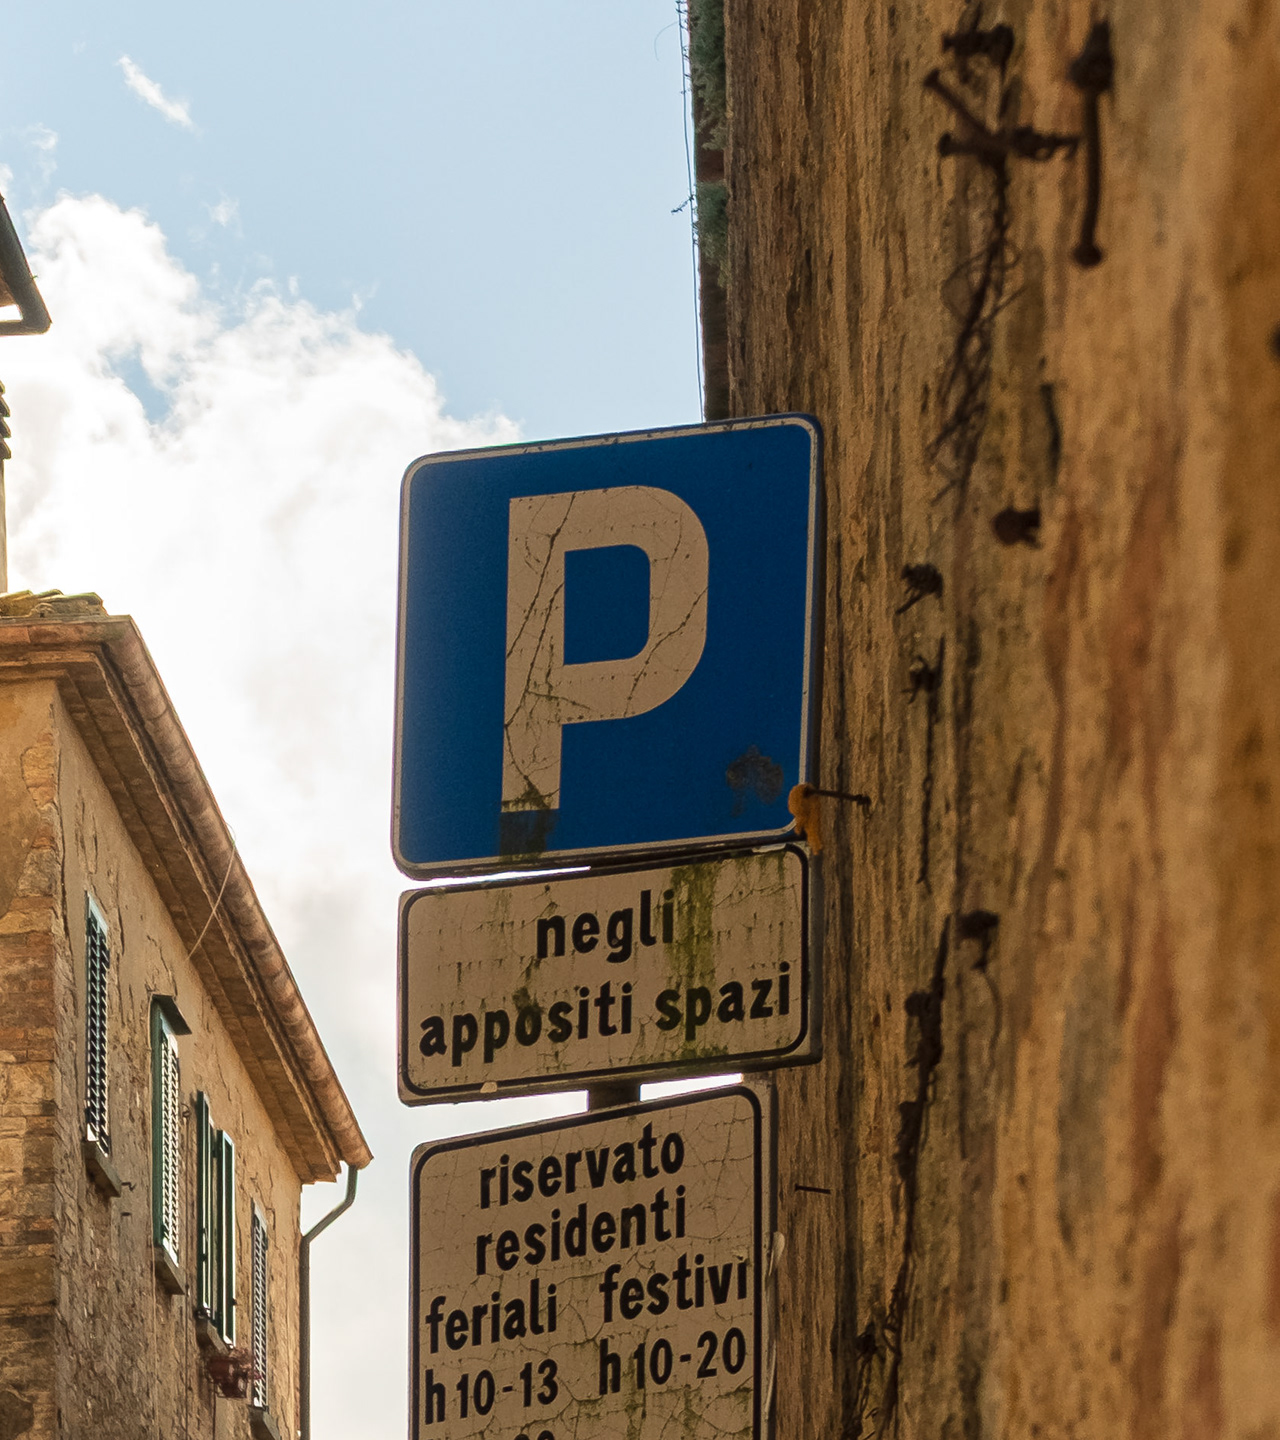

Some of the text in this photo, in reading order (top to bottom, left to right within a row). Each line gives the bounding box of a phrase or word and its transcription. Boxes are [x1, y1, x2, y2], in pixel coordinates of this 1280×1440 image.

[501, 484, 710, 813] P
[537, 889, 675, 963] negli
[419, 960, 790, 1067] appositi spazi
[480, 1121, 684, 1209] riservato
[476, 1184, 686, 1276] residenti
[425, 1252, 748, 1354] feriali festivi
